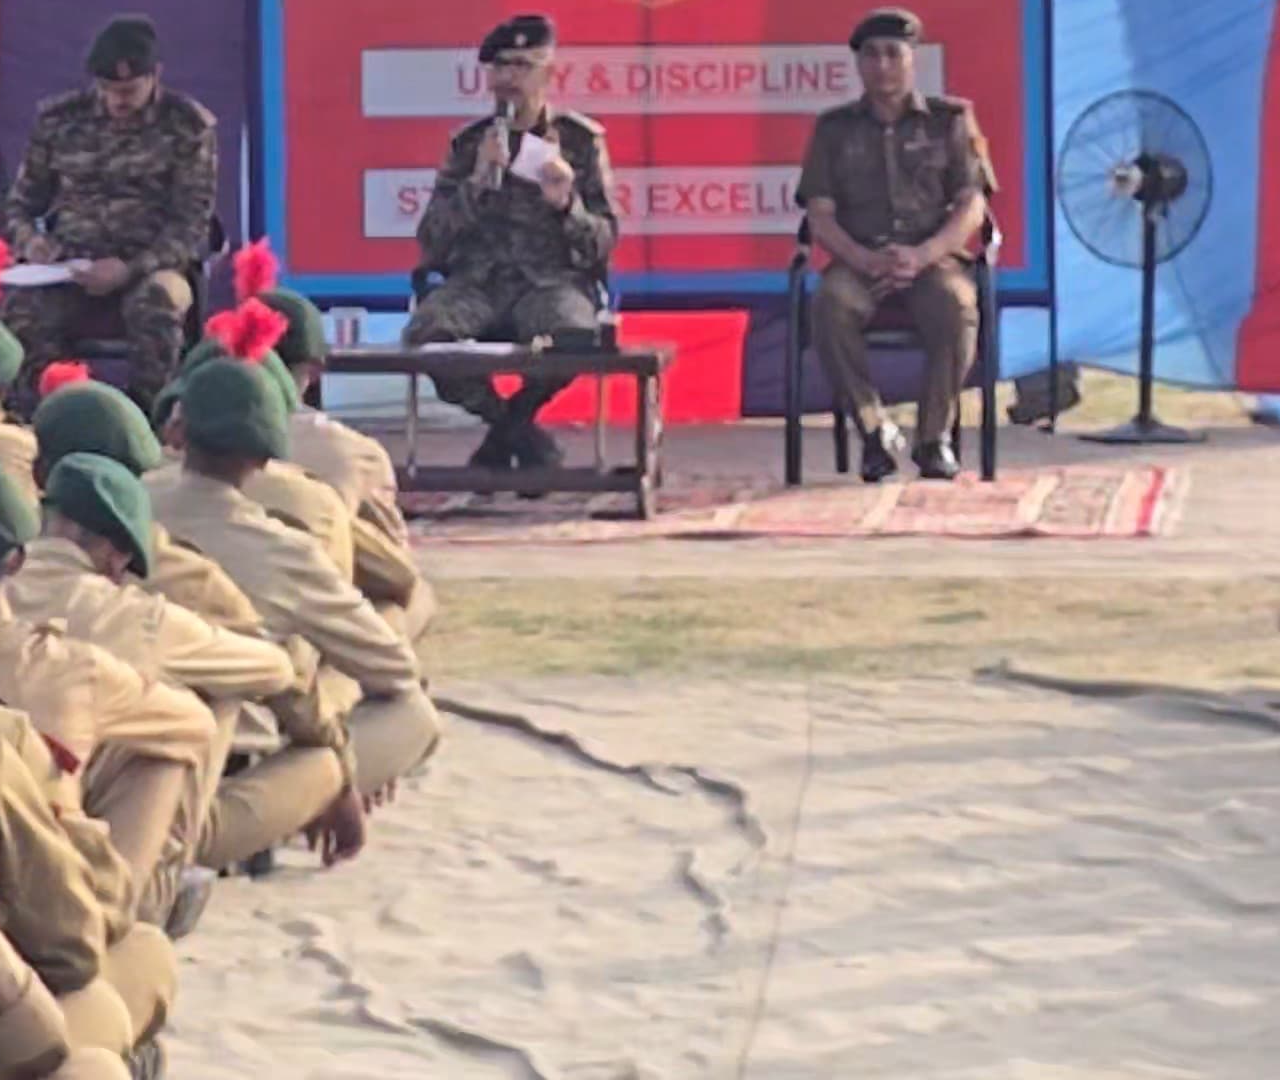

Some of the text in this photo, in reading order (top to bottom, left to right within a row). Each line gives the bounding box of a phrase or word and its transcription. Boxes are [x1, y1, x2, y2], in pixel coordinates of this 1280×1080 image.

[586, 61, 612, 93] &
[626, 61, 849, 94] DISCIPLINE
[647, 182, 800, 215] EXCELL
